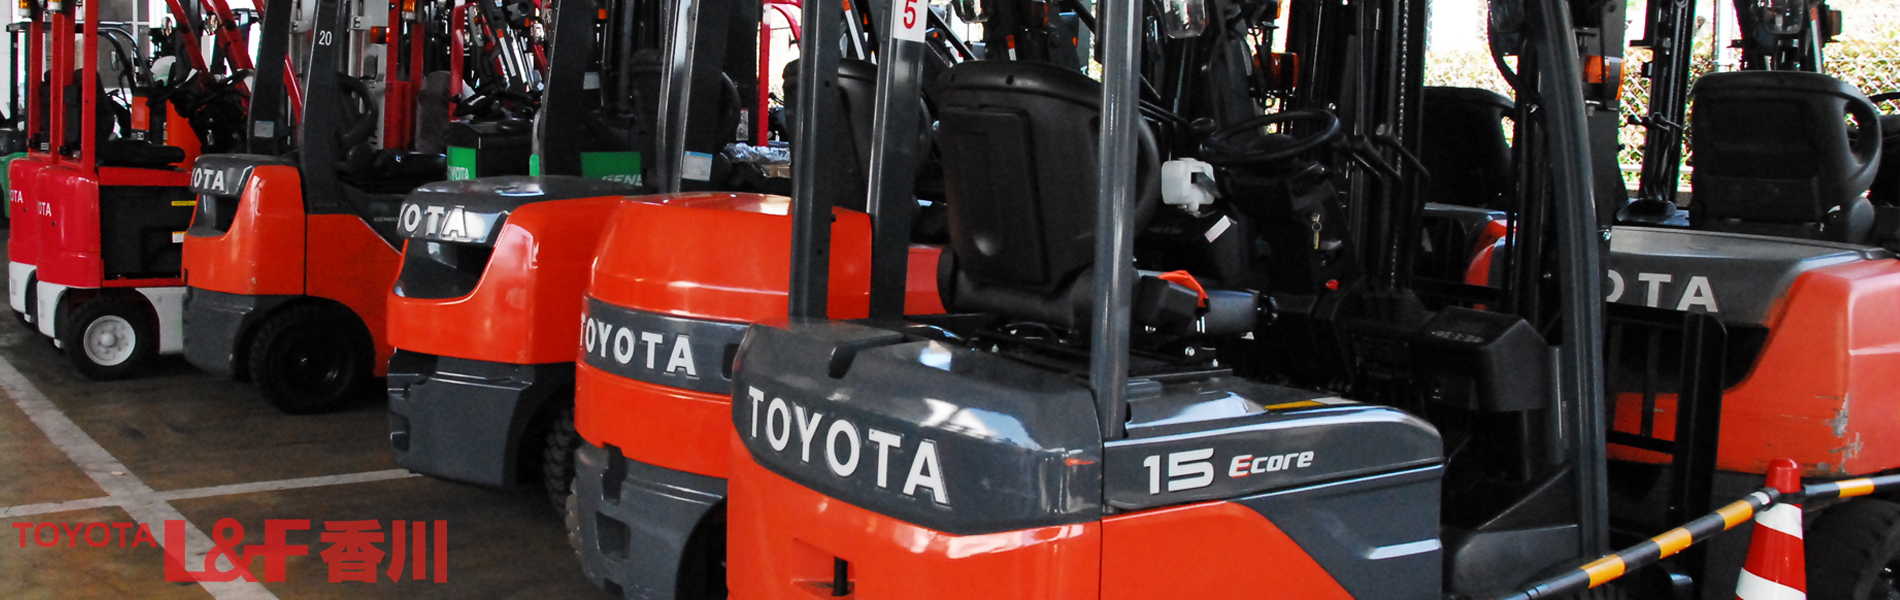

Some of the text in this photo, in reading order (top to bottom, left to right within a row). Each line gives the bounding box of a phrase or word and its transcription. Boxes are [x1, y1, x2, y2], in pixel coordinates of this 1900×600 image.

[903, 0, 917, 29] 5
[318, 30, 332, 46] 20
[190, 167, 225, 191] OTA
[749, 386, 949, 506] TOYOTA
[1143, 447, 1314, 495] 15 Ecore
